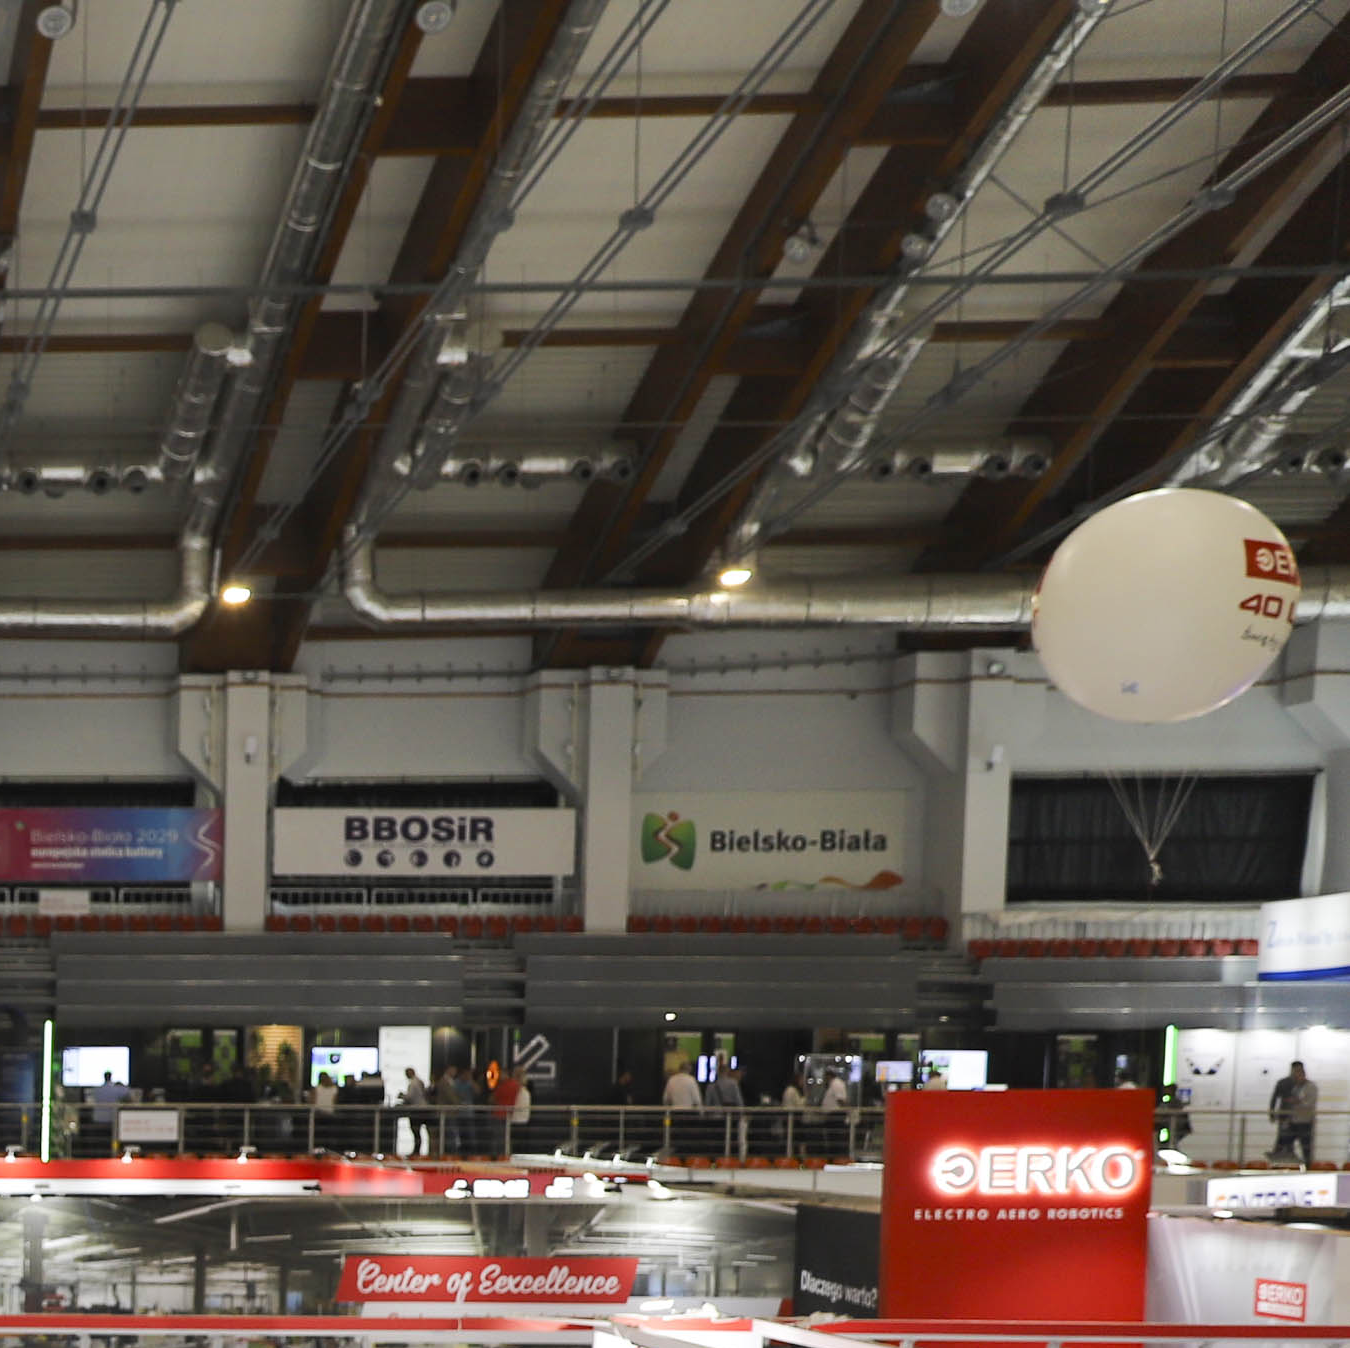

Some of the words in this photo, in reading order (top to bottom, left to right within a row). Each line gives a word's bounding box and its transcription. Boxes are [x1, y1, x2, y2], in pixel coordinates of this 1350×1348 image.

[344, 815, 494, 842] BBOSiR
[709, 828, 887, 855] Bielsko-Biała
[978, 1145, 1140, 1196] ERKO
[914, 1208, 990, 1221] ELECTRO
[996, 1208, 1041, 1221] AERO
[1047, 1207, 1124, 1220] ROBOTICS
[356, 1258, 442, 1295] Center
[447, 1270, 474, 1303] of
[800, 1269, 843, 1303] Dlaczego
